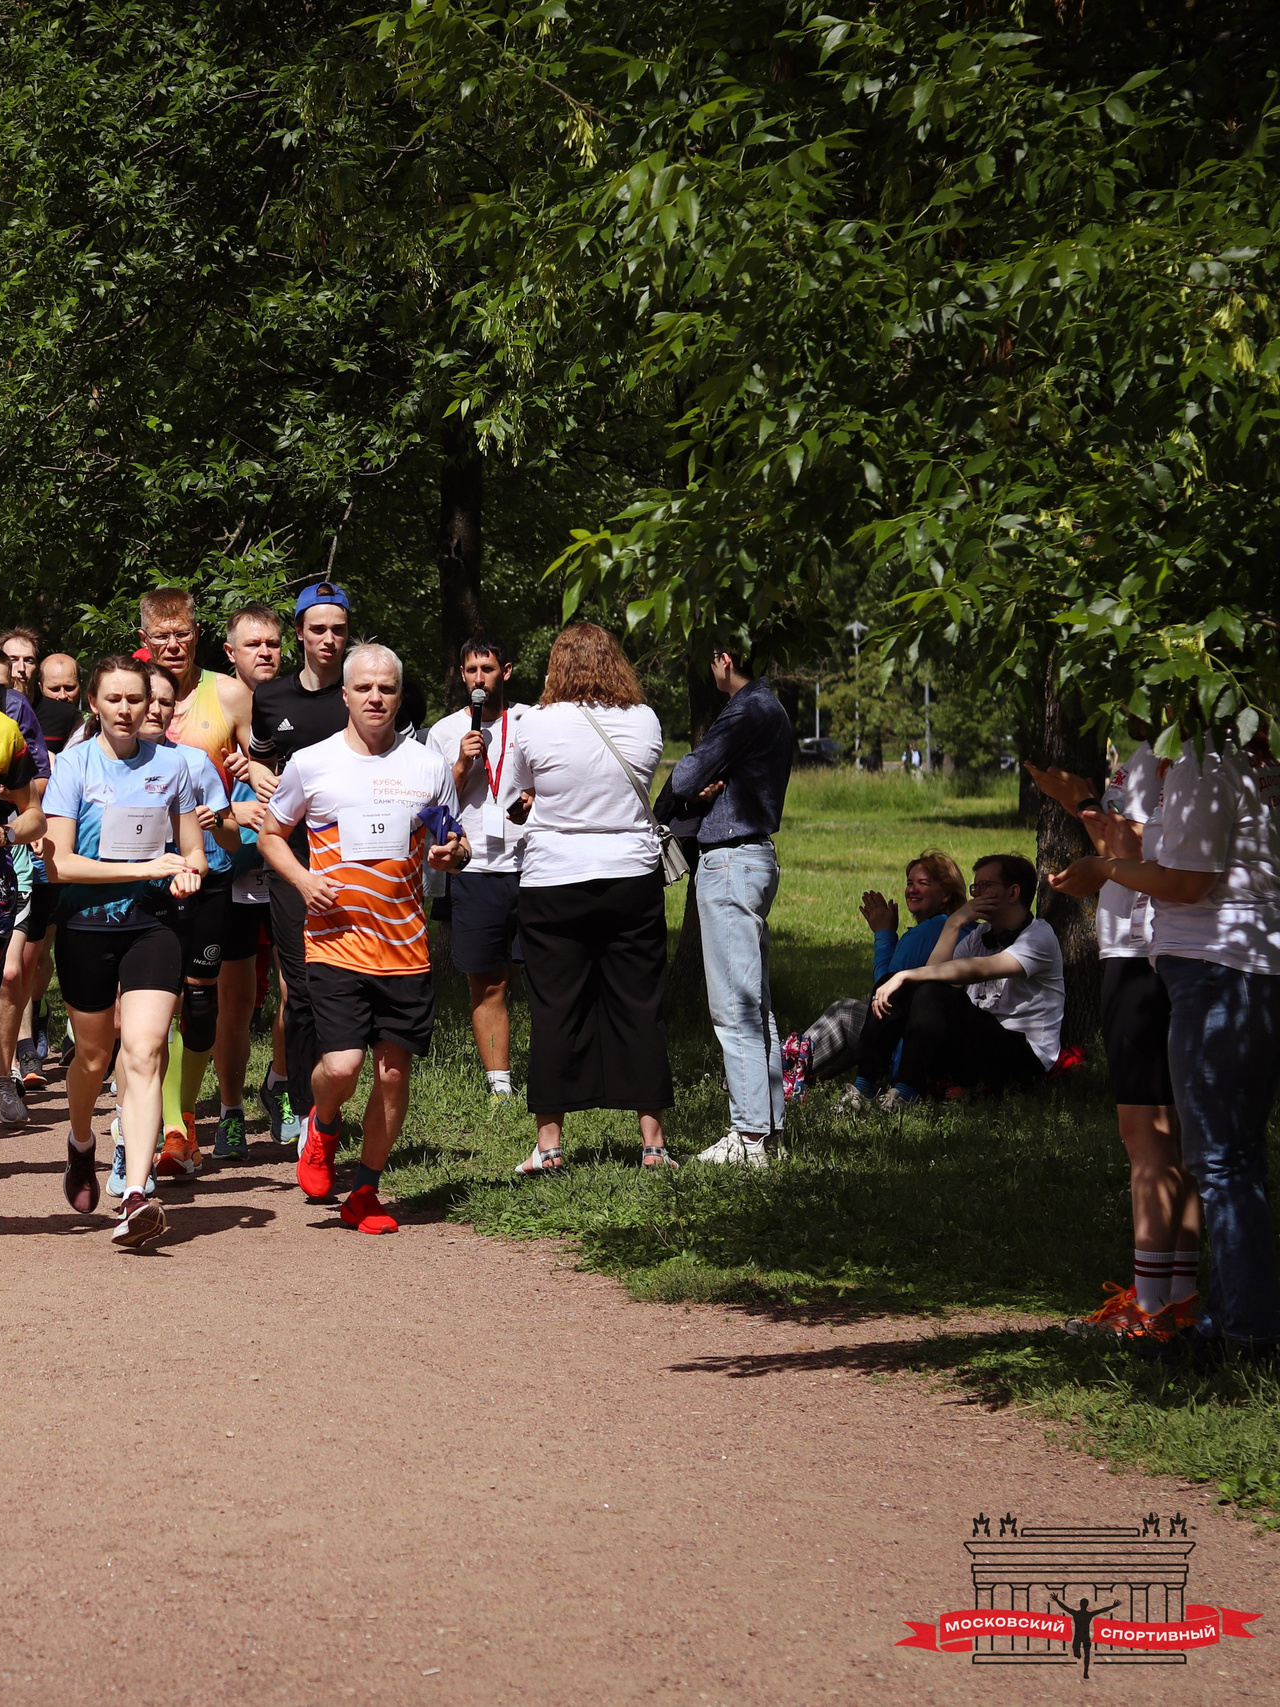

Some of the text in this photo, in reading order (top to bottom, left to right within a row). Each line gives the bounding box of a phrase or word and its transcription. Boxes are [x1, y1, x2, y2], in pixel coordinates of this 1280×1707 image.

[373, 788, 432, 799] ГУБЕРНАТОРА
[136, 824, 143, 835] 9
[371, 823, 385, 834] 19
[256, 874, 268, 886] 5
